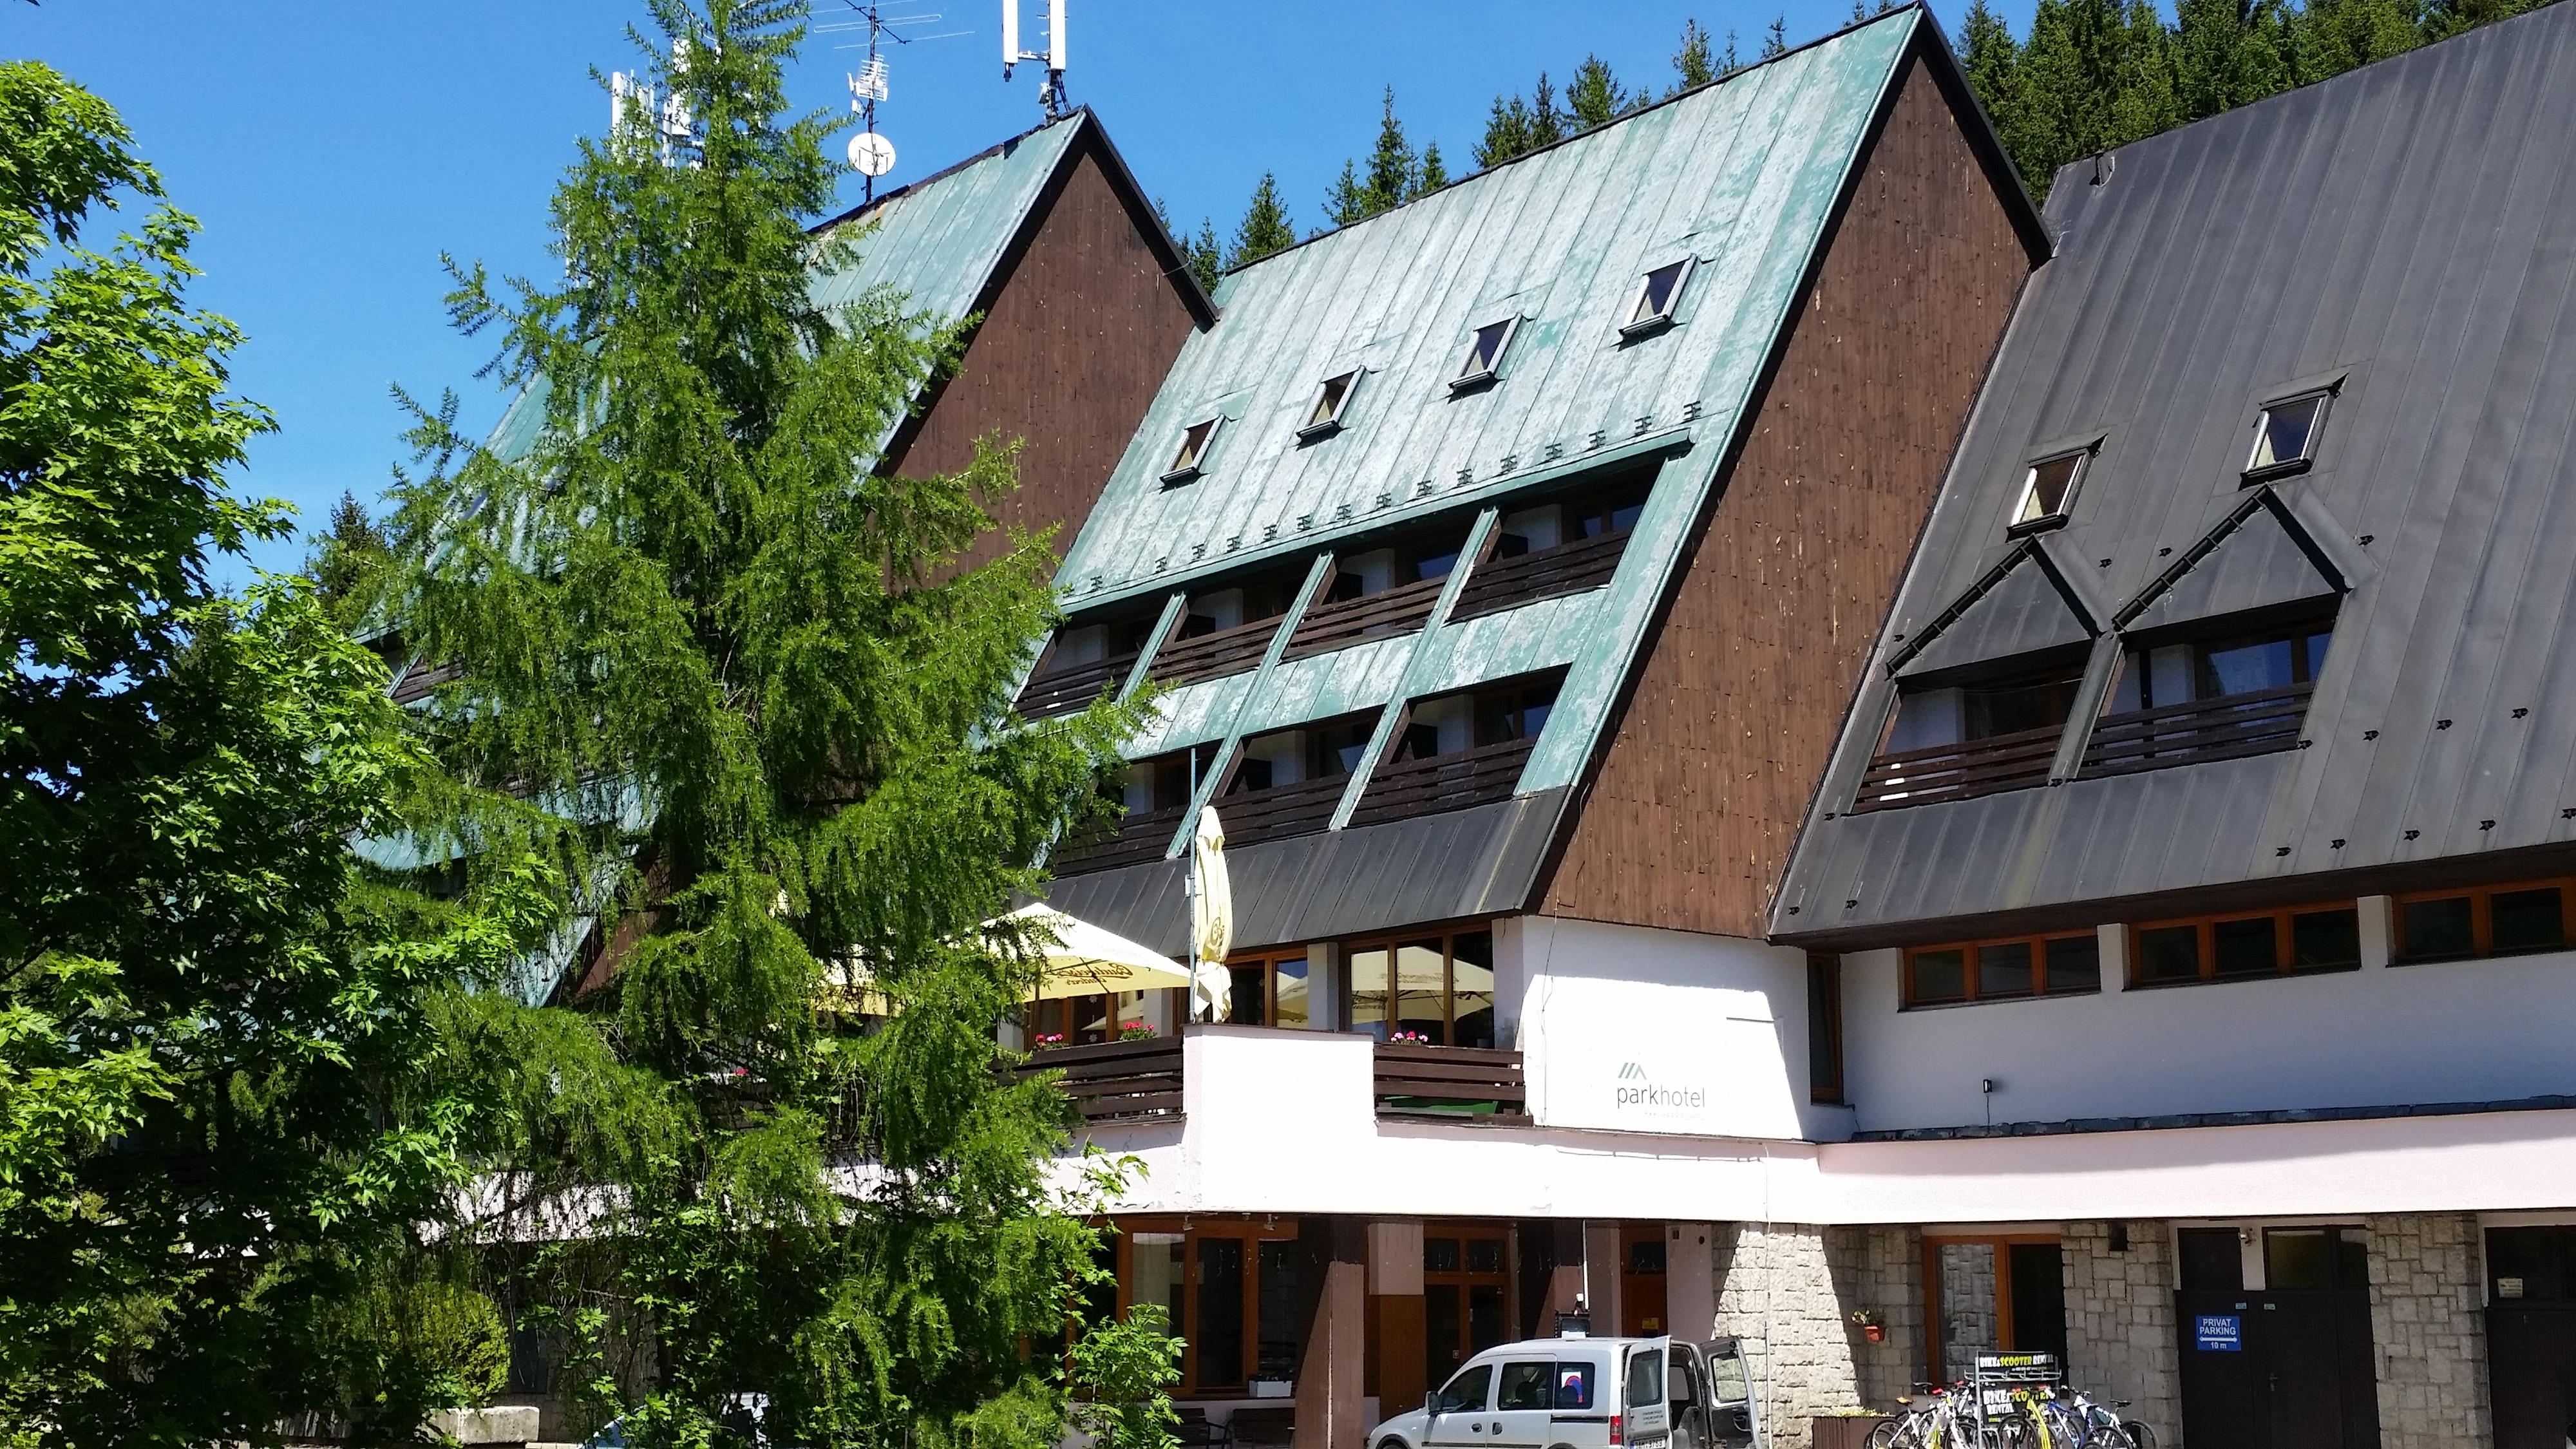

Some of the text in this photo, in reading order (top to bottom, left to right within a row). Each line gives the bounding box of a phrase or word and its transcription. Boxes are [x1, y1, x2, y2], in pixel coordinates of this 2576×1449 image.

[1617, 1084, 1705, 1109] parkhotel
[2202, 1318, 2231, 1327] PRIVAT
[2199, 1327, 2236, 1335] PARKING
[2032, 1354, 2054, 1365] RENTAL
[1986, 1403, 2014, 1415] RENTAL
